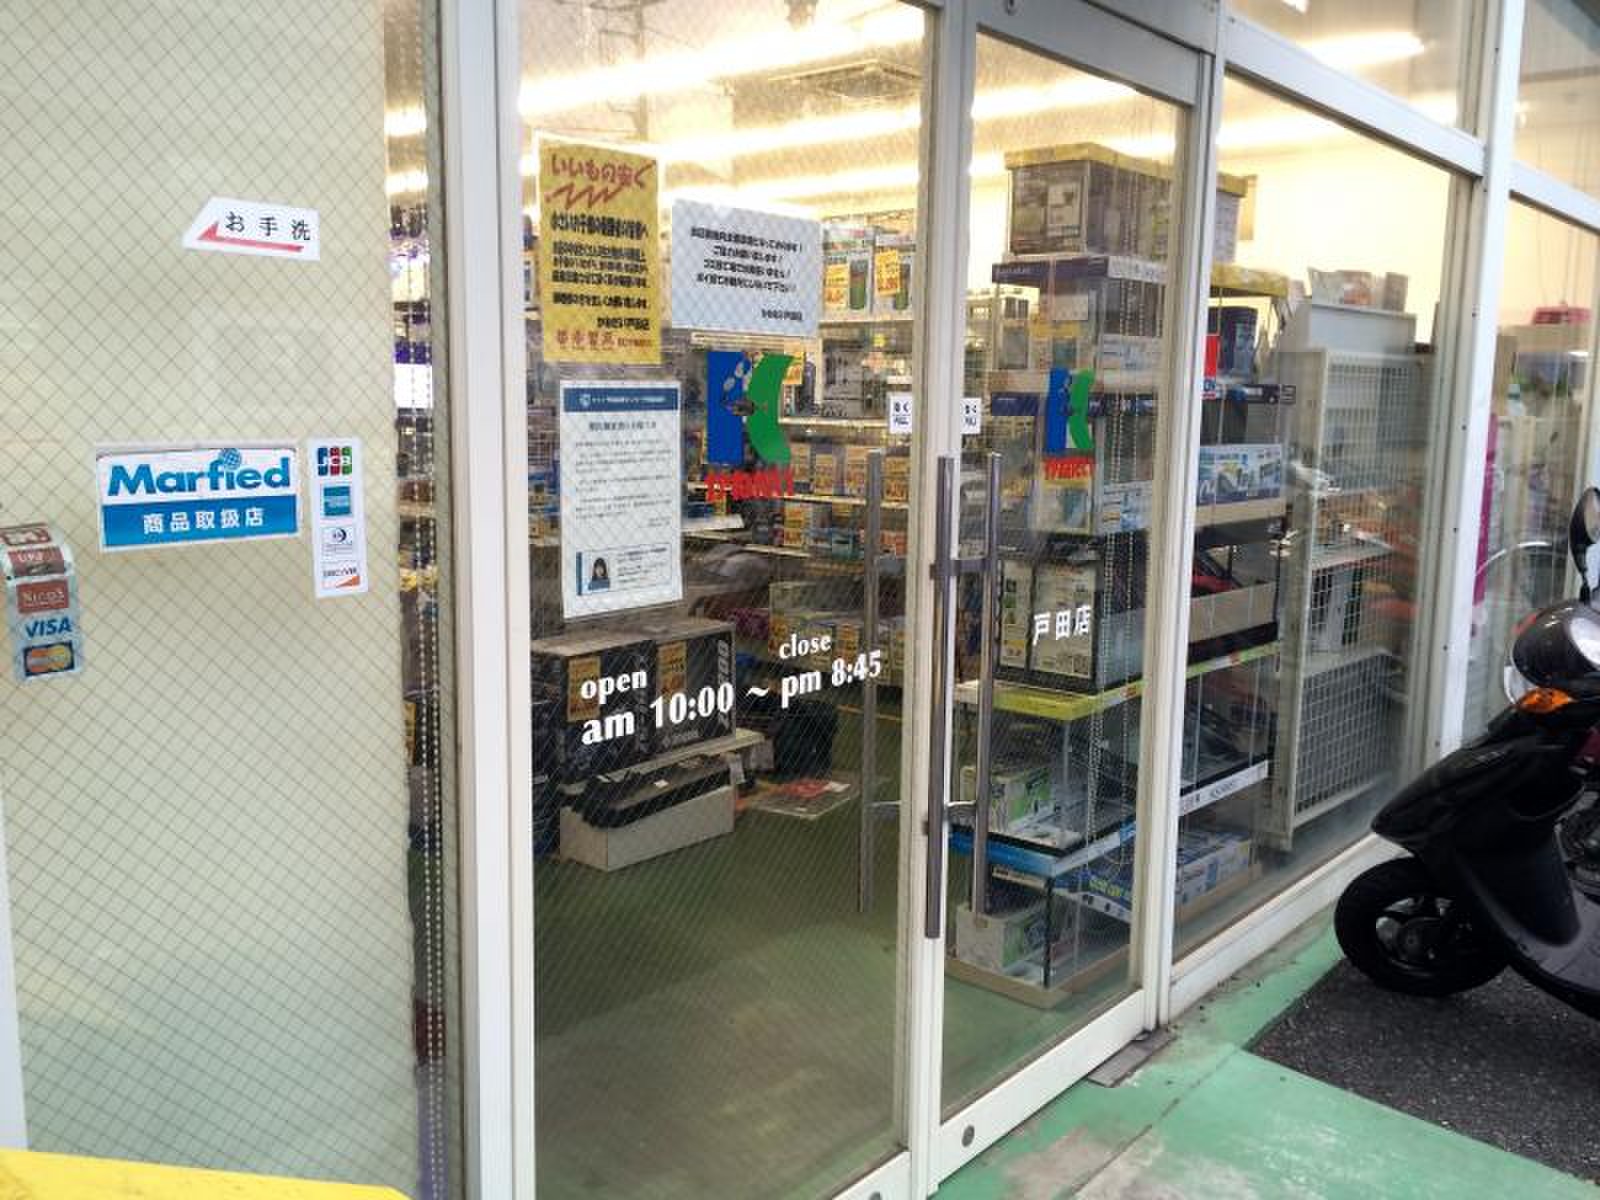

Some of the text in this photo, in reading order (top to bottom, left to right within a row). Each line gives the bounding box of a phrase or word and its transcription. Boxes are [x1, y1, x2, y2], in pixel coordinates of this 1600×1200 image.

[225, 210, 311, 242] お手洗
[107, 453, 291, 497] Marfied
[143, 507, 265, 535] 商品取扱店
[26, 617, 73, 638] VISA
[1032, 605, 1091, 646] 戸田店
[779, 632, 832, 659] close
[580, 669, 648, 705] open
[581, 710, 636, 746] am
[649, 682, 735, 729] 10:00
[780, 670, 822, 708] pm
[831, 649, 882, 687] 8:45
